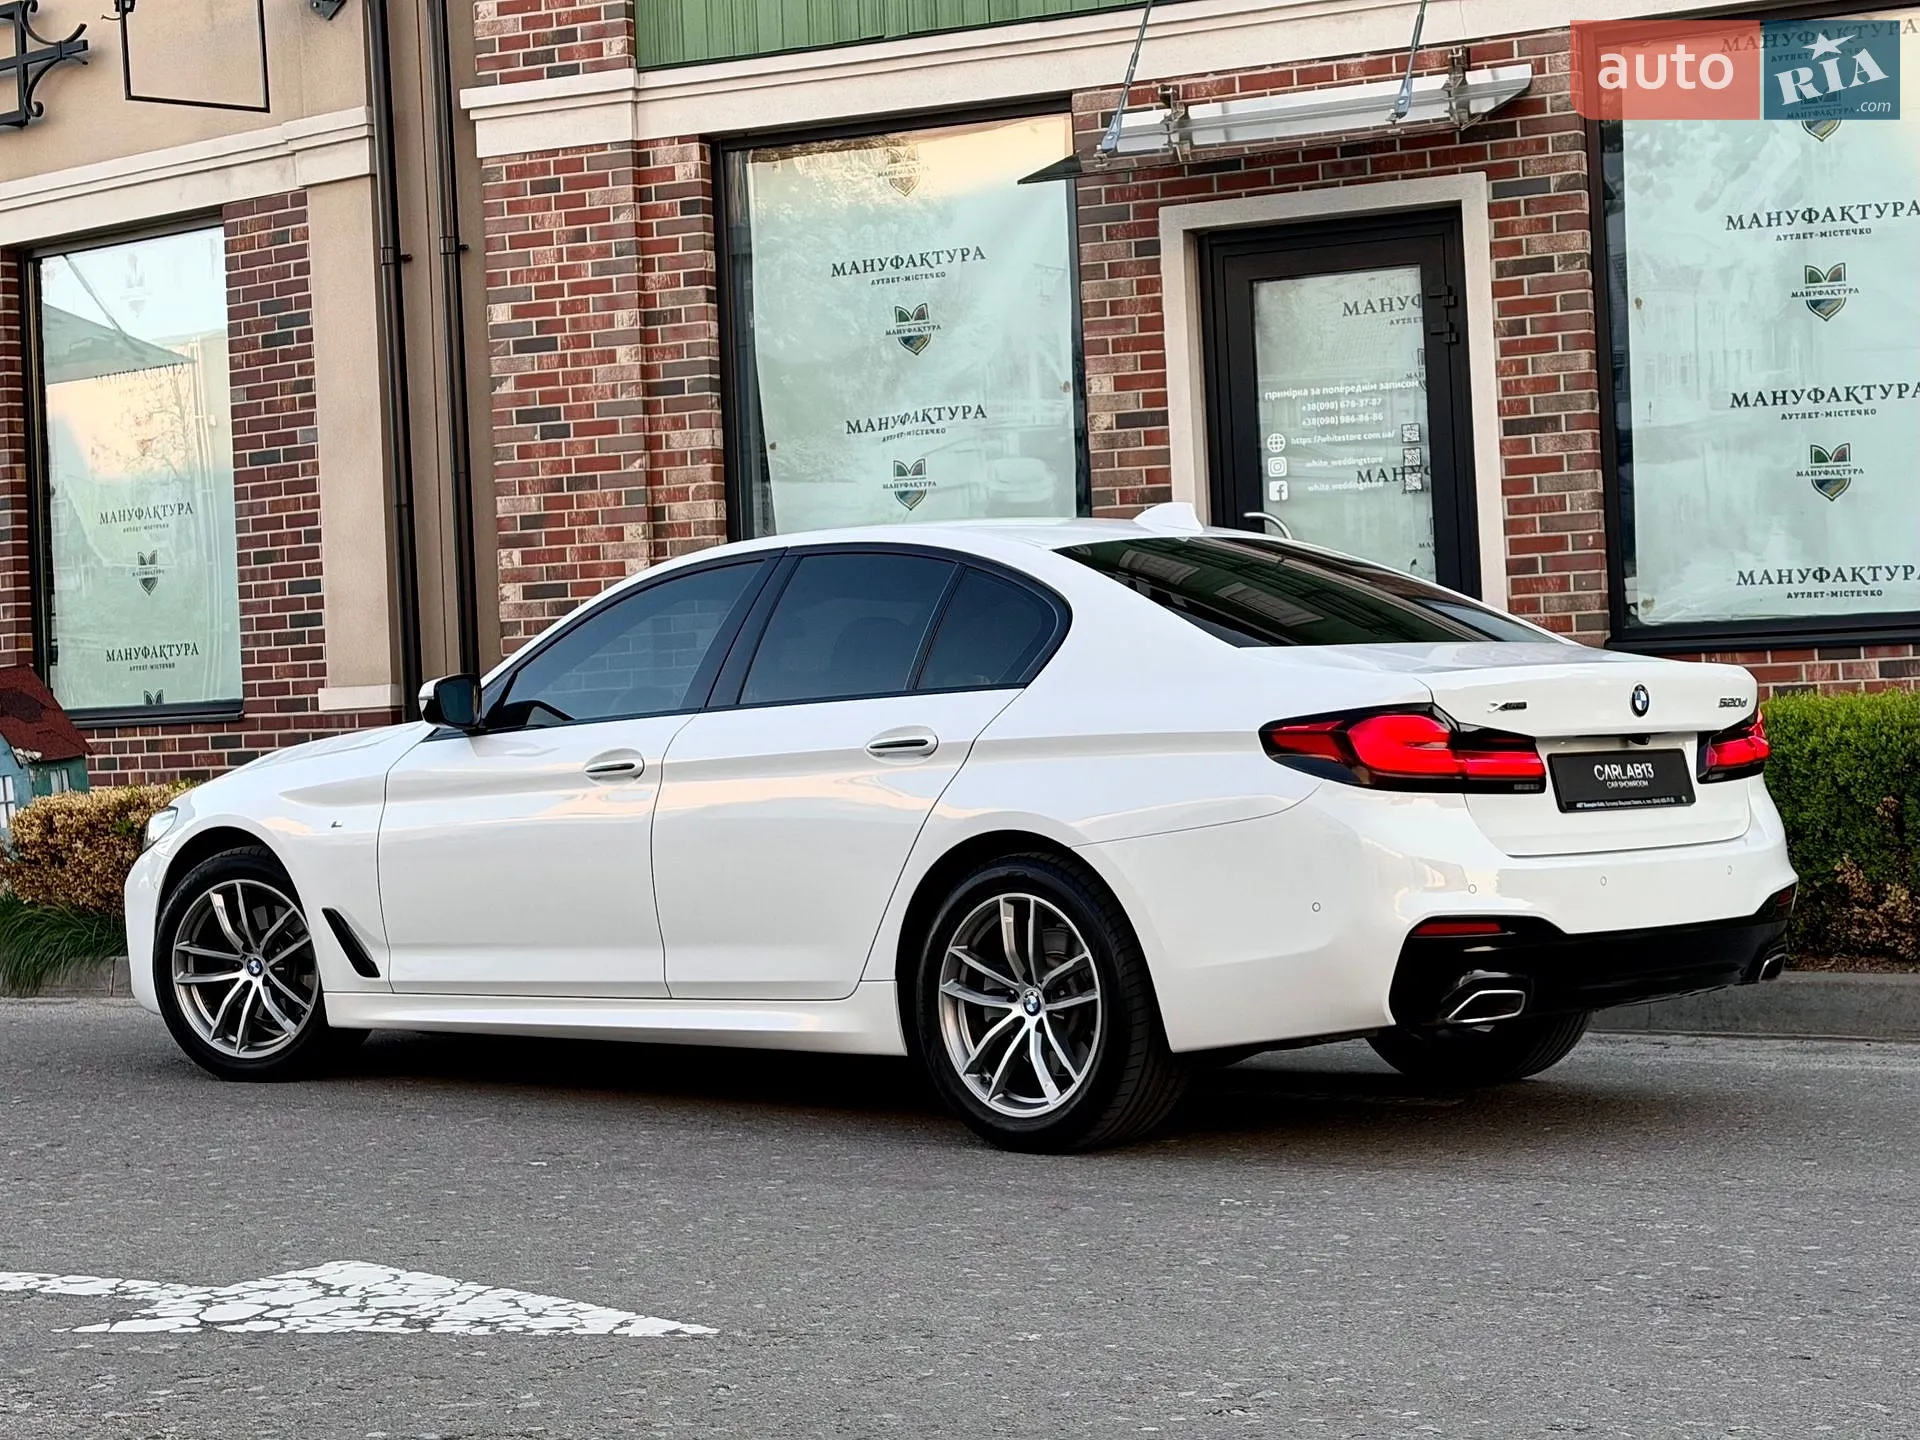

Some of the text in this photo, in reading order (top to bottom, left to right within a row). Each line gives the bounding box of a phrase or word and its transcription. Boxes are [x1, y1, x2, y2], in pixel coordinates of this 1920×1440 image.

[1725, 199, 1920, 230] МАНУФАКТУРА
[830, 245, 986, 277] МАНУФАКТУРА
[846, 404, 987, 434] МАНУФАКТУРА
[1781, 408, 1877, 420] АУТЛЕТ-МІСТЕЧКО
[99, 501, 194, 525] МАНУФАКТУРА
[1736, 564, 1920, 587] МАНУФАКТУР
[1786, 589, 1883, 600] АУТЛЕТ-МІСТЕЧКО
[106, 642, 199, 662] МАНУФАКТУРА
[1719, 697, 1748, 708] 520d
[1594, 762, 1654, 781] CARLAB13
[1606, 780, 1618, 789] CAR
